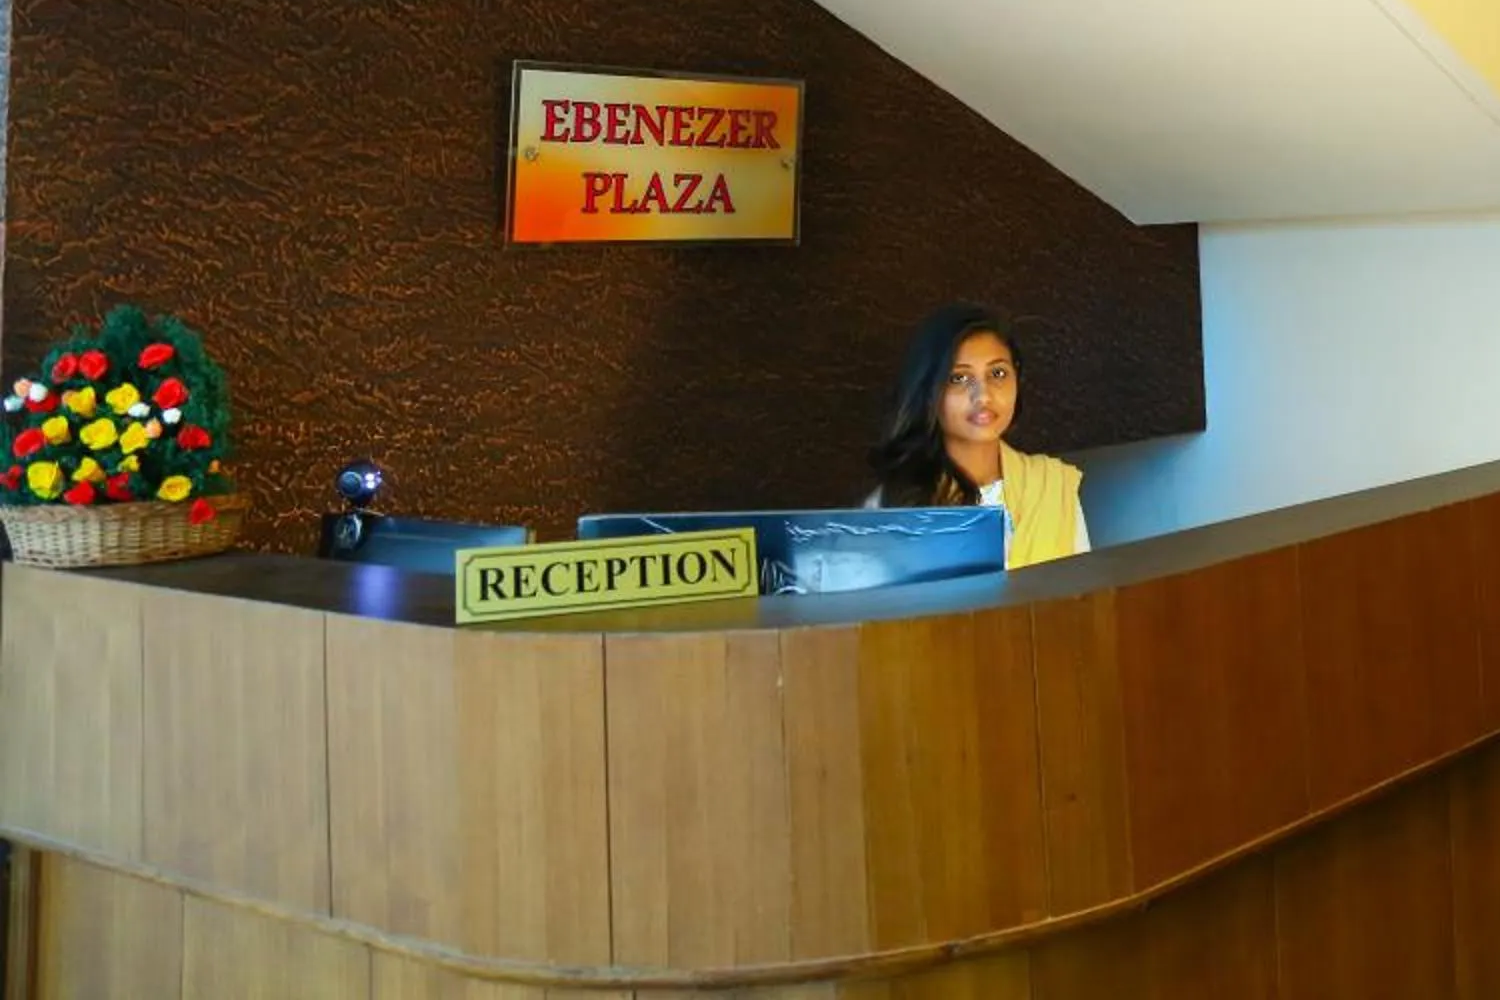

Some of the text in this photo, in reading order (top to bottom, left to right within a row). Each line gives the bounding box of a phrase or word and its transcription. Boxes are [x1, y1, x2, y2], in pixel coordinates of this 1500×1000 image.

[540, 99, 781, 149] EBENEZER
[580, 171, 736, 215] PLAZA
[478, 548, 737, 601] RECEPTION
